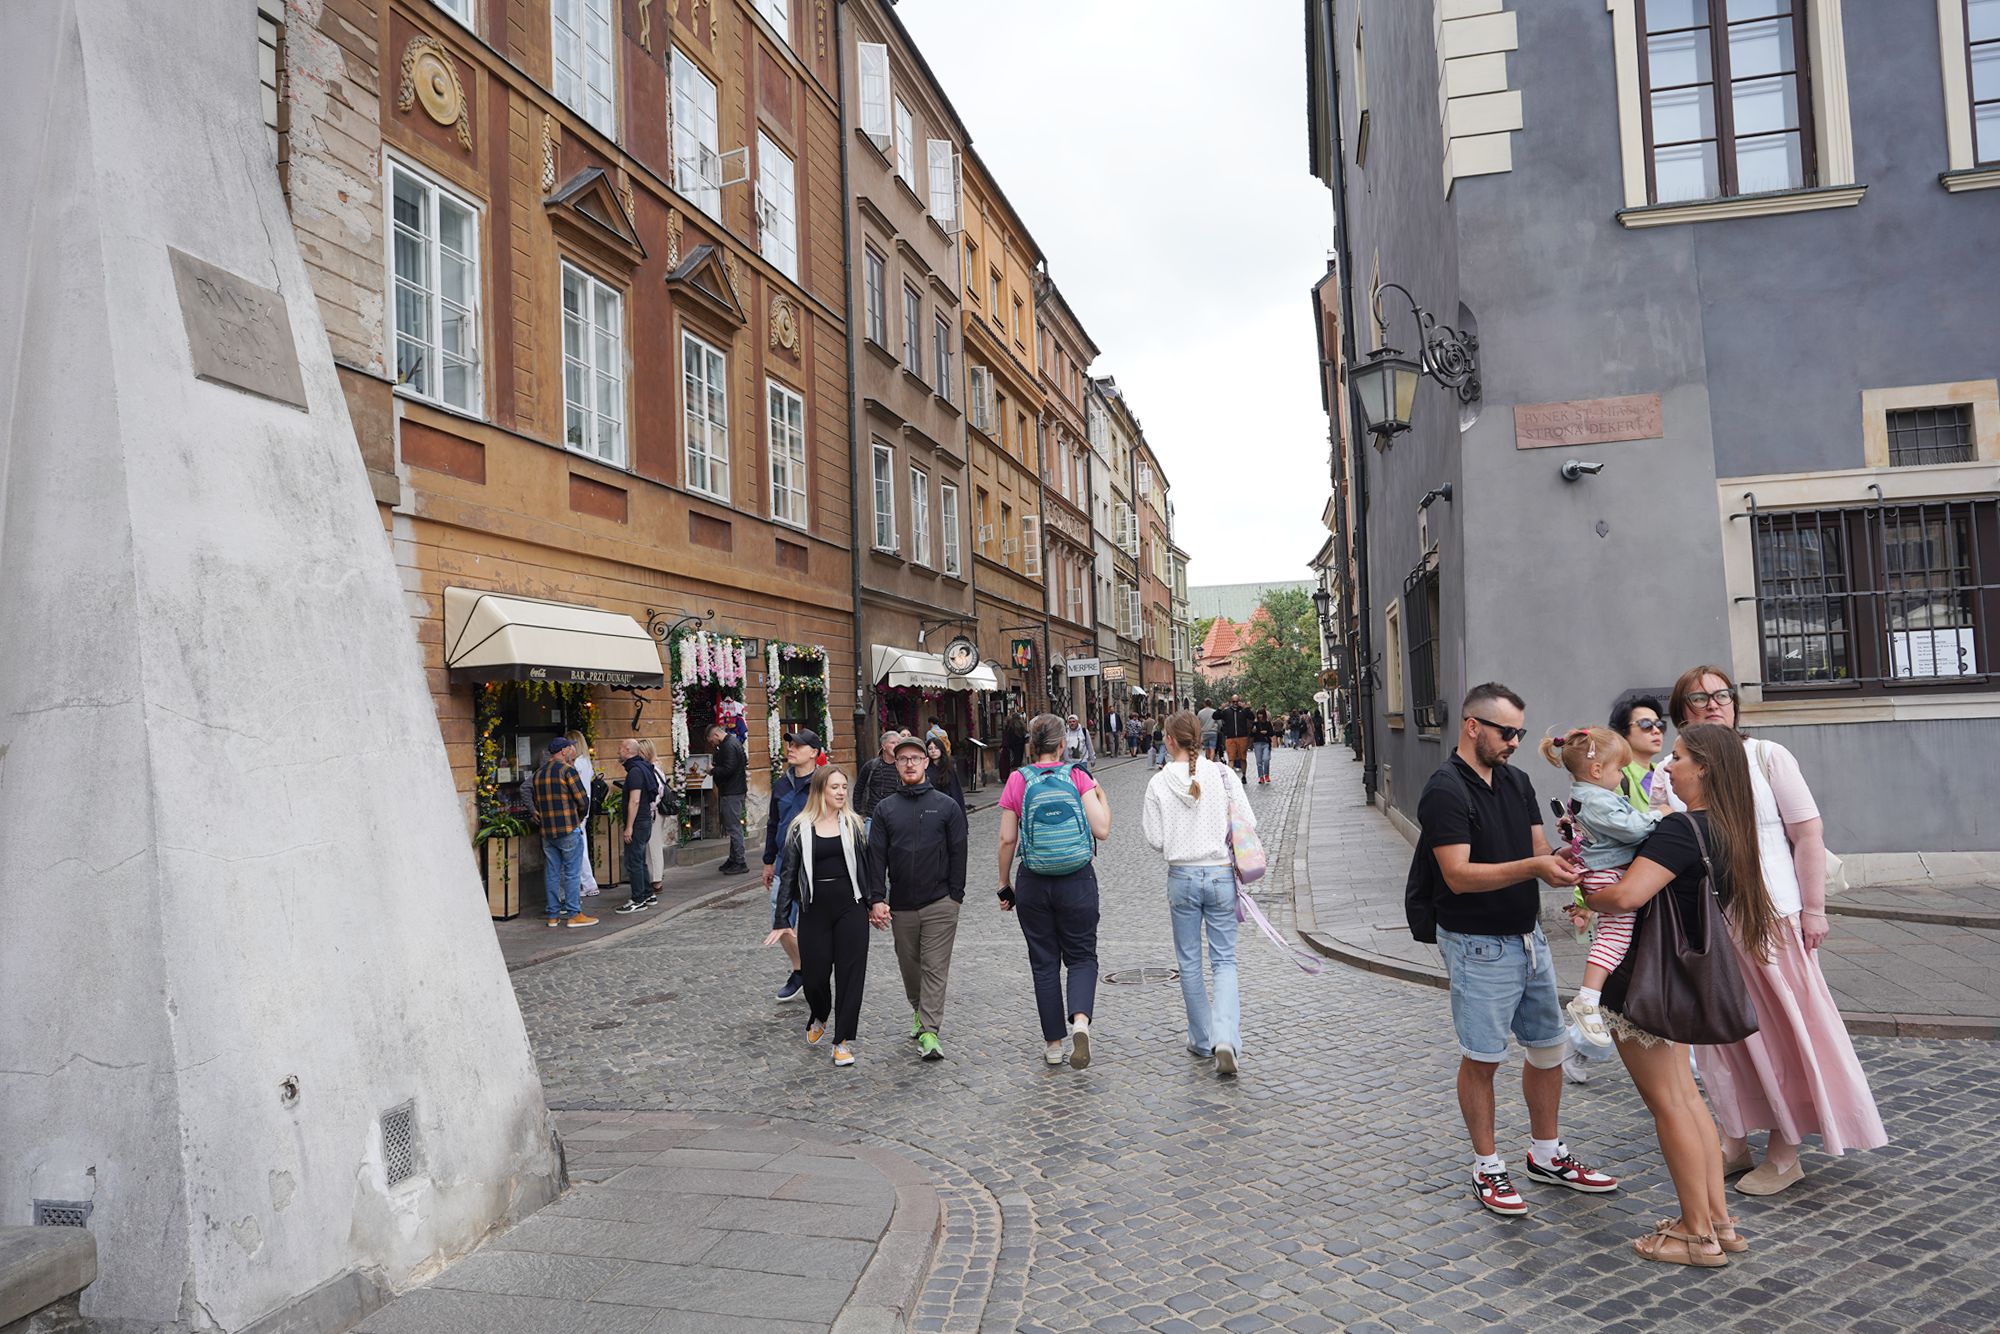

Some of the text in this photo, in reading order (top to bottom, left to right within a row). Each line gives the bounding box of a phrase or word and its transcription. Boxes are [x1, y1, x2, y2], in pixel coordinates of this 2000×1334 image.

[1524, 410, 1569, 425] RYNEK
[1525, 423, 1585, 440] STRONA
[570, 670, 586, 680] BAR
